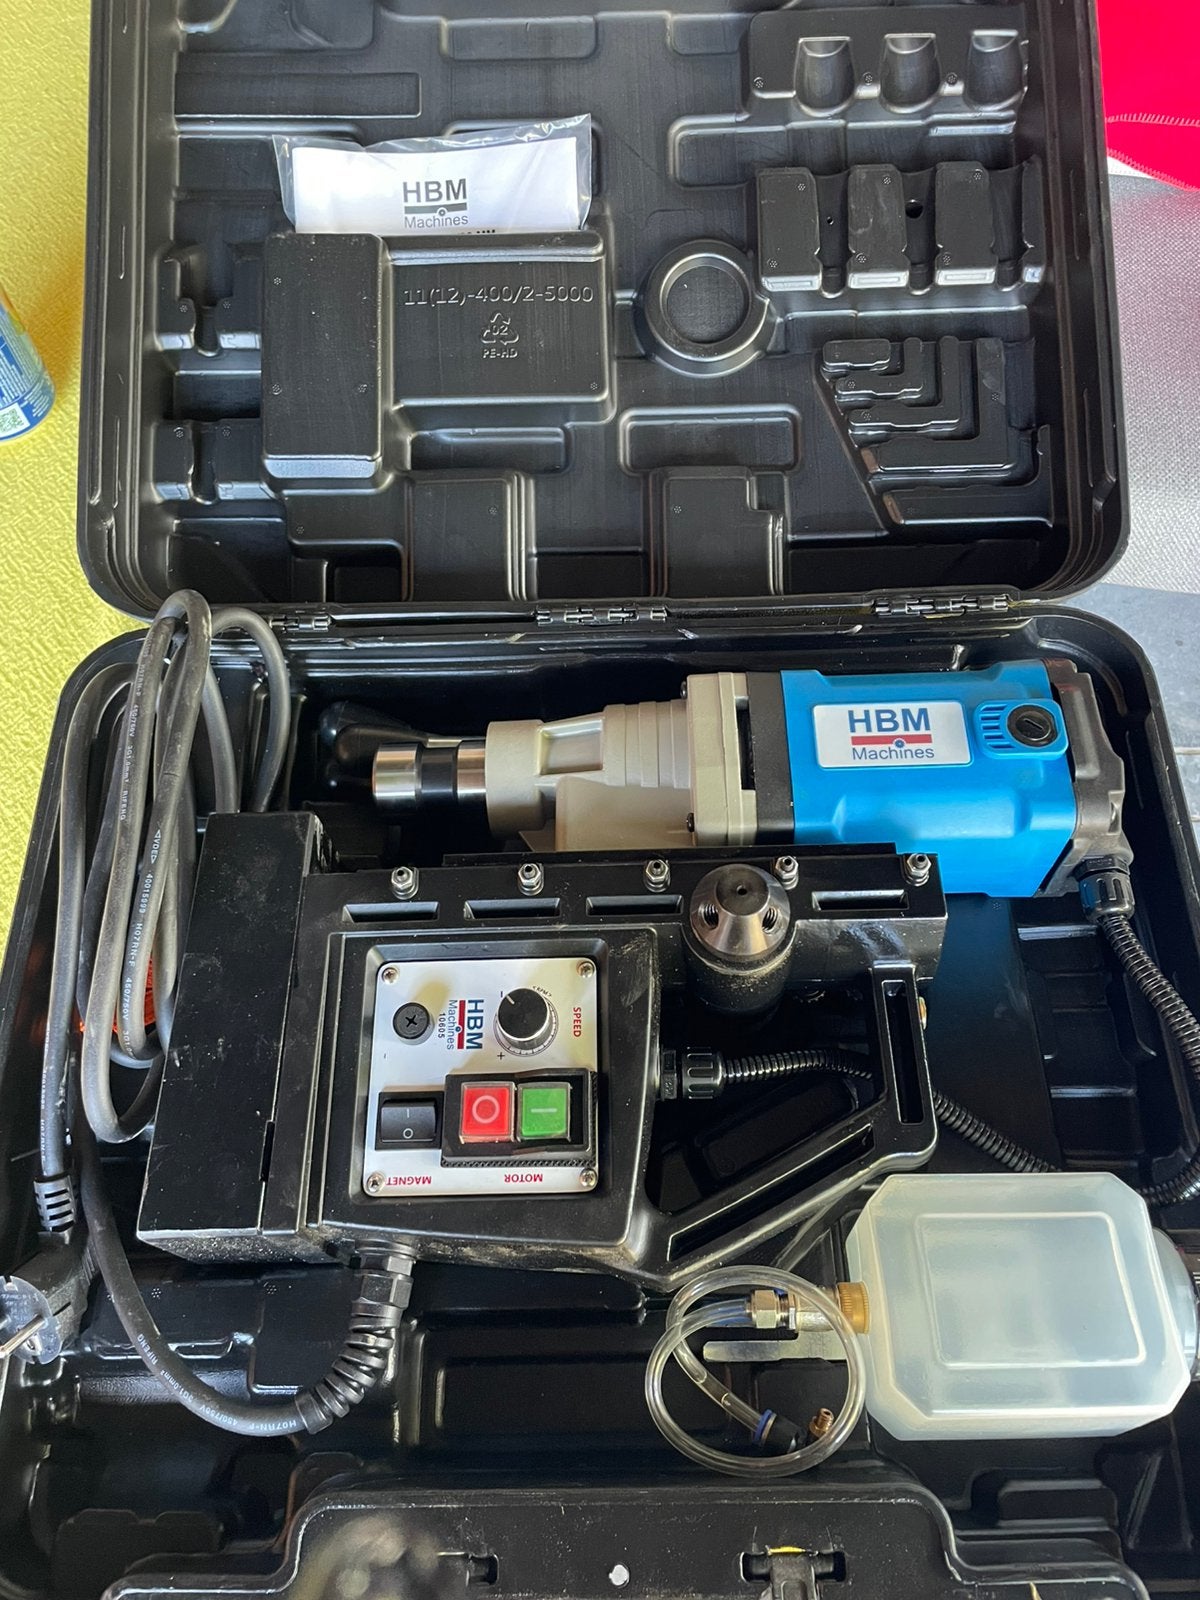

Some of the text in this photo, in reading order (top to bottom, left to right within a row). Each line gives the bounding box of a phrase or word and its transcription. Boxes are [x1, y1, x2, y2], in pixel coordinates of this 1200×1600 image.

[403, 178, 467, 203] HBM
[404, 215, 469, 229] Machines
[847, 707, 930, 733] HBM
[852, 747, 935, 761] Machines
[128, 923, 143, 968] H07RN-F
[437, 1012, 446, 1039] 10605
[446, 999, 458, 1050] Machines
[466, 999, 484, 1050] HBM
[573, 1007, 582, 1037] SPEED
[386, 1175, 432, 1186] MAGNET
[504, 1173, 544, 1183] MOTOR
